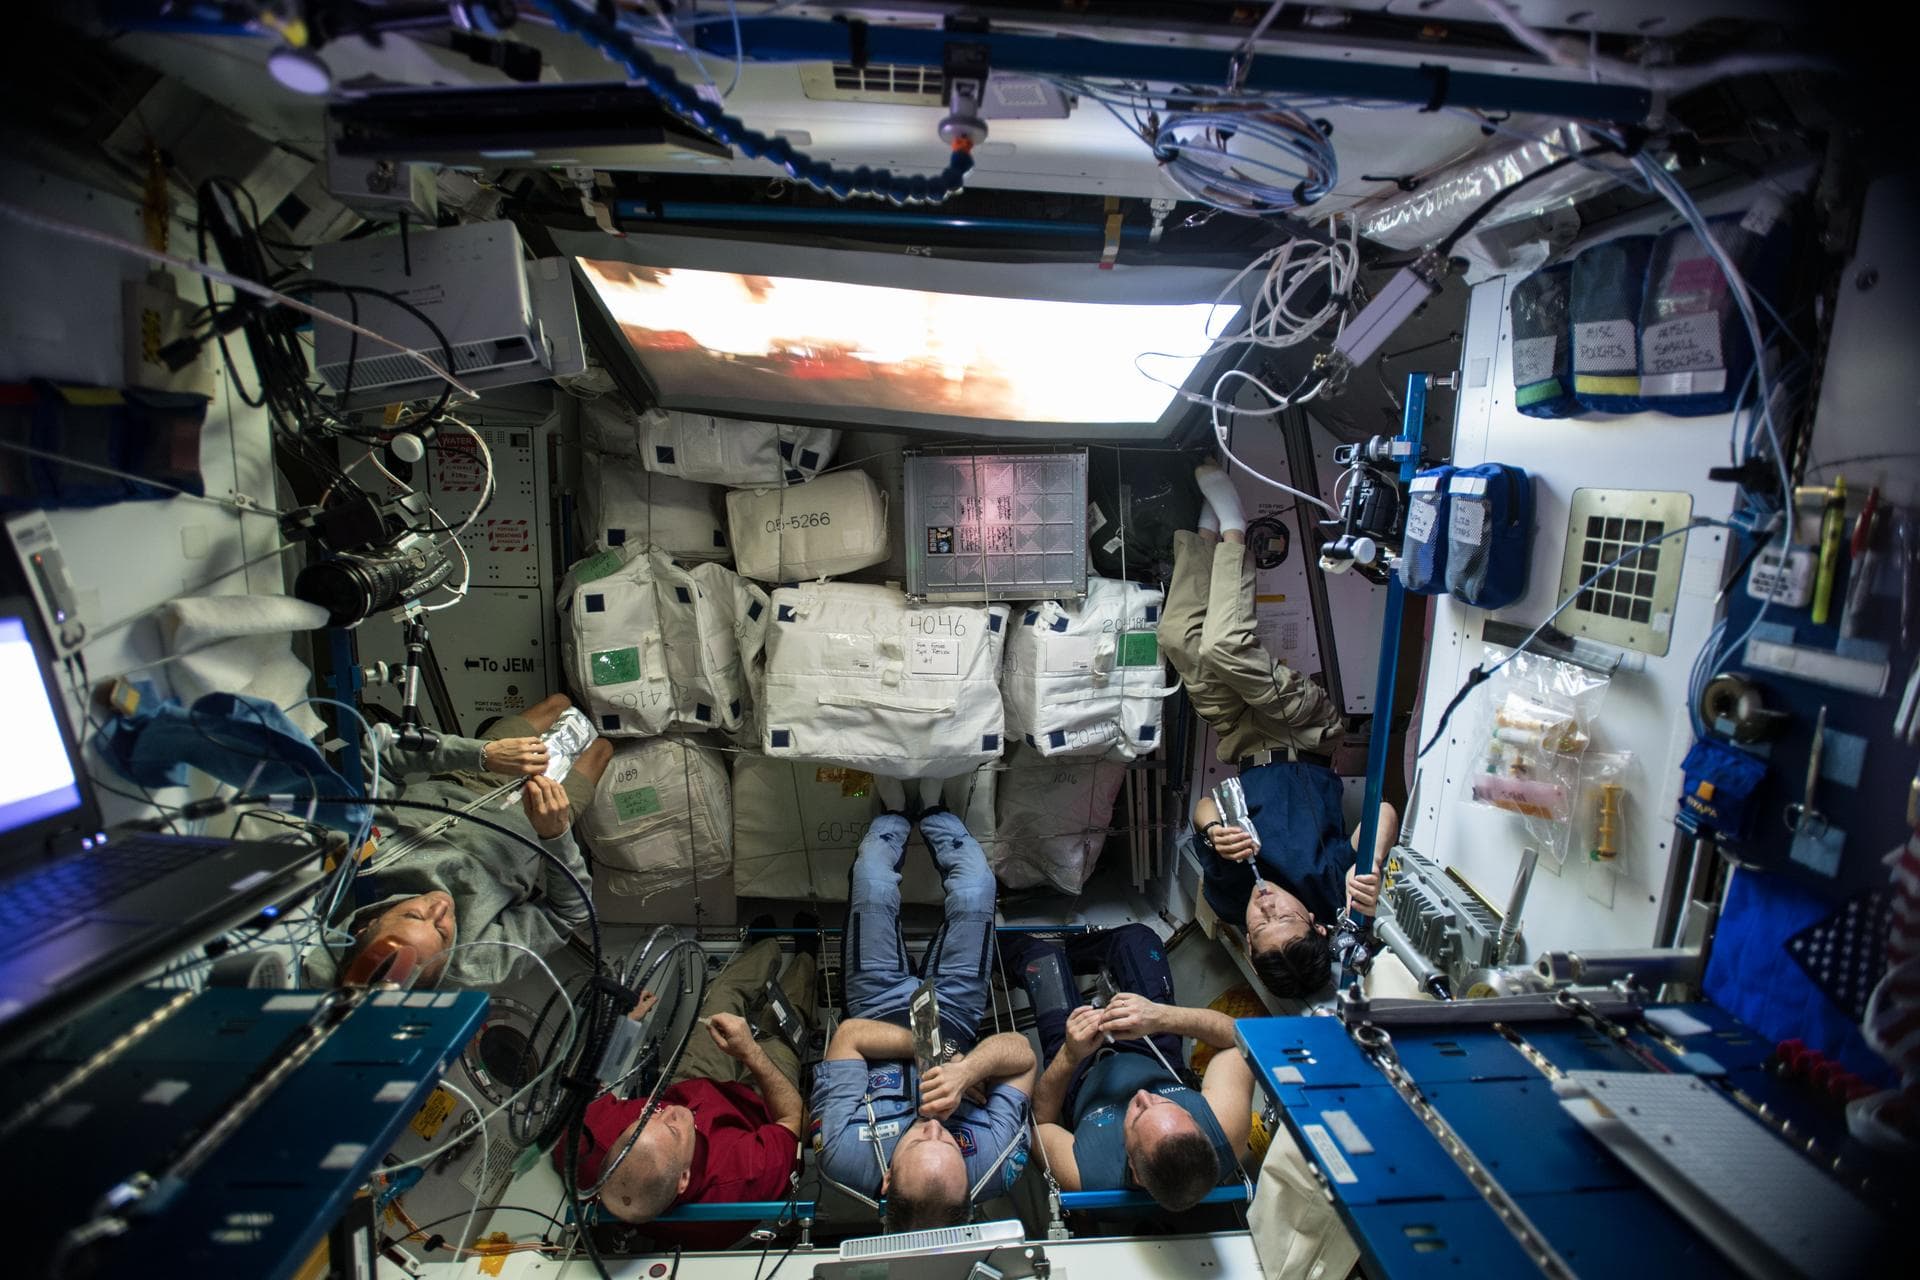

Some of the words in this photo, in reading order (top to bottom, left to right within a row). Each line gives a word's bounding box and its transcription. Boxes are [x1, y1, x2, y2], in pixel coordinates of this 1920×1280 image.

[441, 437, 474, 446] WATER
[911, 615, 966, 637] 4046
[479, 657, 498, 672] To
[502, 657, 535, 672] JEM
